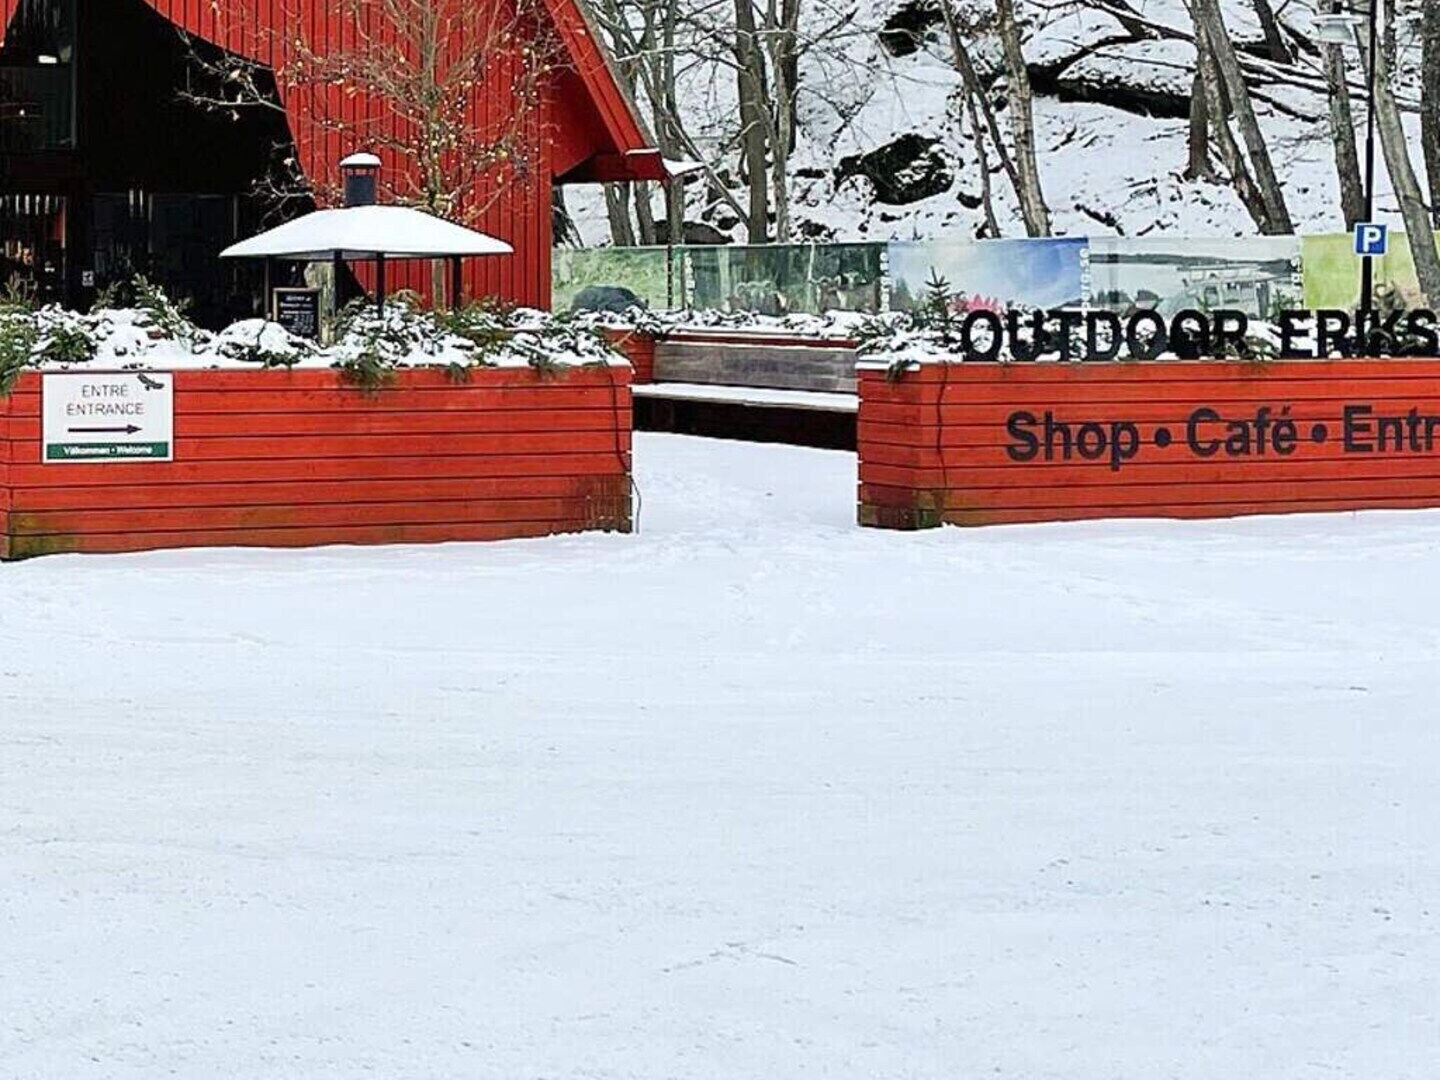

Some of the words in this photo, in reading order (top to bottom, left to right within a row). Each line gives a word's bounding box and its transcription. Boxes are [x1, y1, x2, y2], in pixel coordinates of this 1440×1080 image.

[1363, 226, 1381, 252] P
[962, 309, 1248, 361] OUTDOOR
[1280, 309, 1439, 358] ERIKS
[66, 403, 145, 416] ENTRANCE
[1006, 410, 1139, 471] Shop
[1187, 405, 1297, 456] Café
